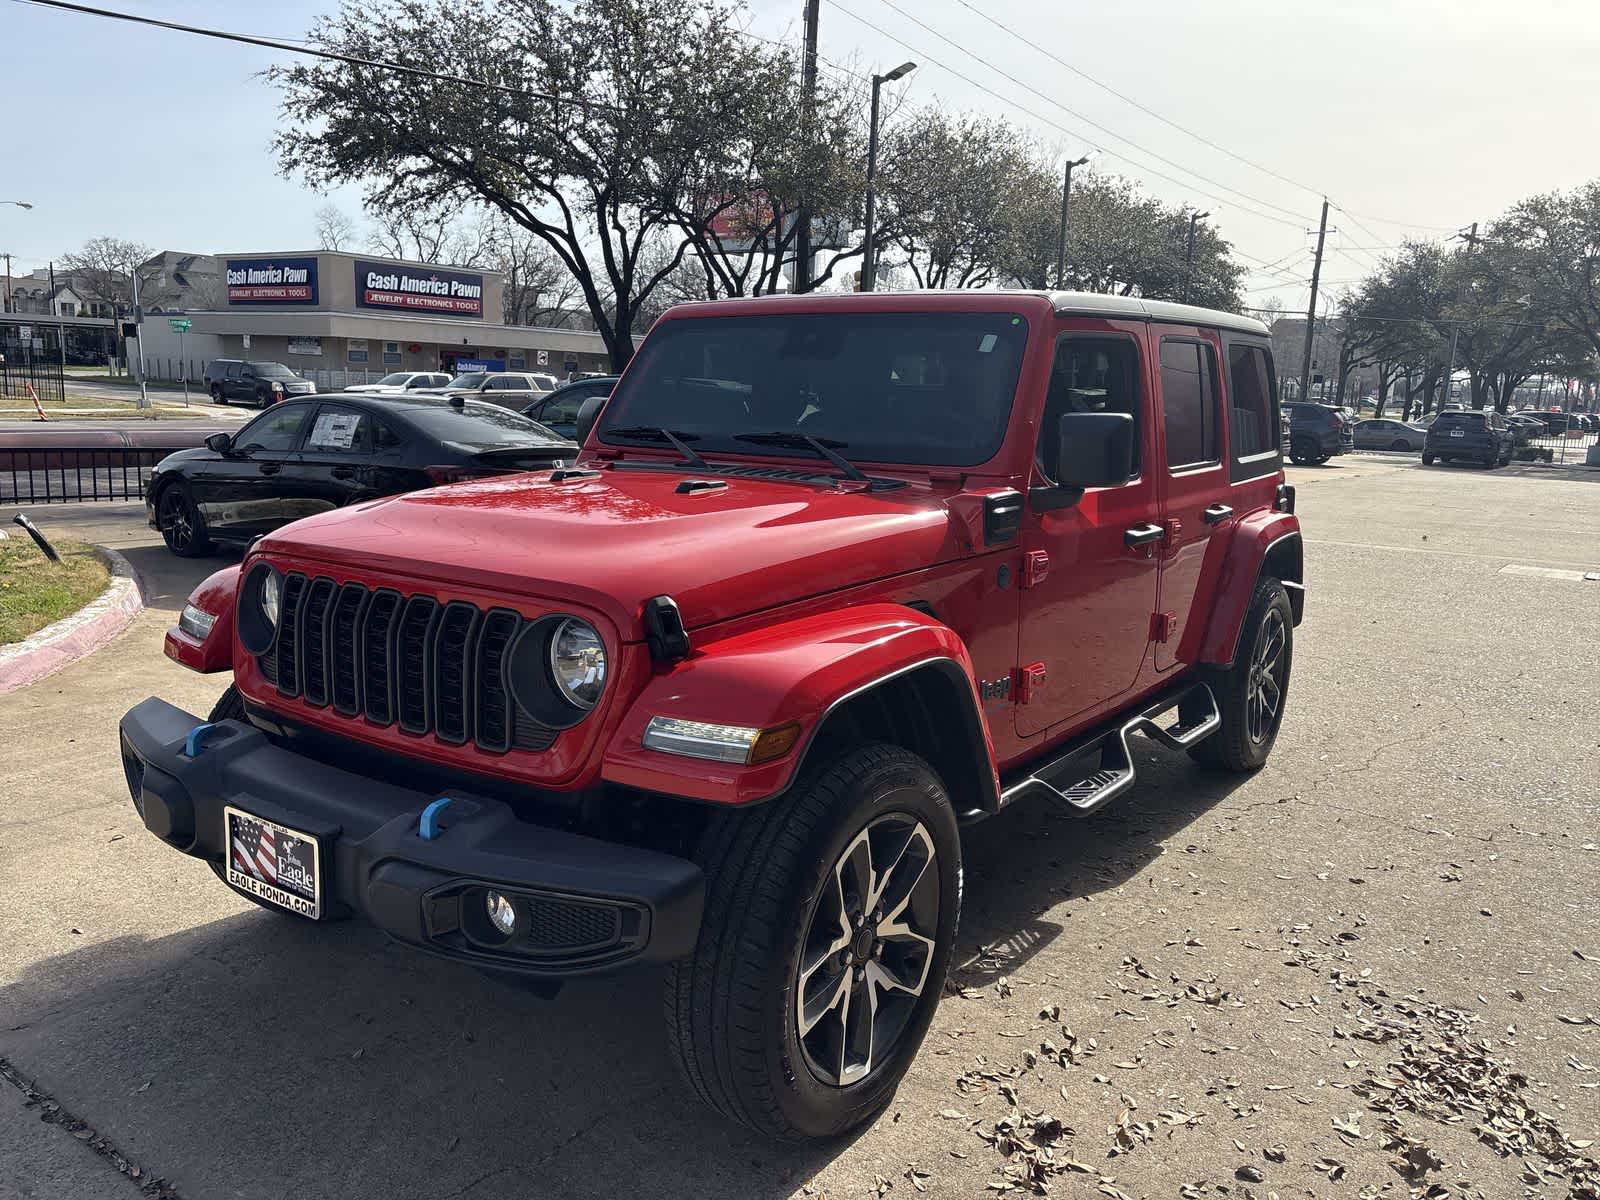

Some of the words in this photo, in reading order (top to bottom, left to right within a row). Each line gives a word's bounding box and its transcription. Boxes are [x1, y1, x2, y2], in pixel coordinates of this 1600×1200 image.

[227, 268, 246, 285] Cash
[247, 268, 282, 284] America
[283, 266, 307, 283] Pawn
[367, 272, 398, 291] Cash
[400, 275, 449, 295] America
[450, 281, 481, 298] Pawn
[230, 289, 251, 297] JEWELRY
[253, 289, 286, 297] ELECTRONICS
[289, 289, 306, 297] TOOLS
[371, 293, 403, 304] JEWELRY
[406, 297, 454, 309] ELECTRONICS
[456, 301, 478, 310] TOOLS
[277, 856, 313, 888] Eagle
[230, 870, 257, 894] EAGLE
[260, 885, 315, 917] HONDA.COM
